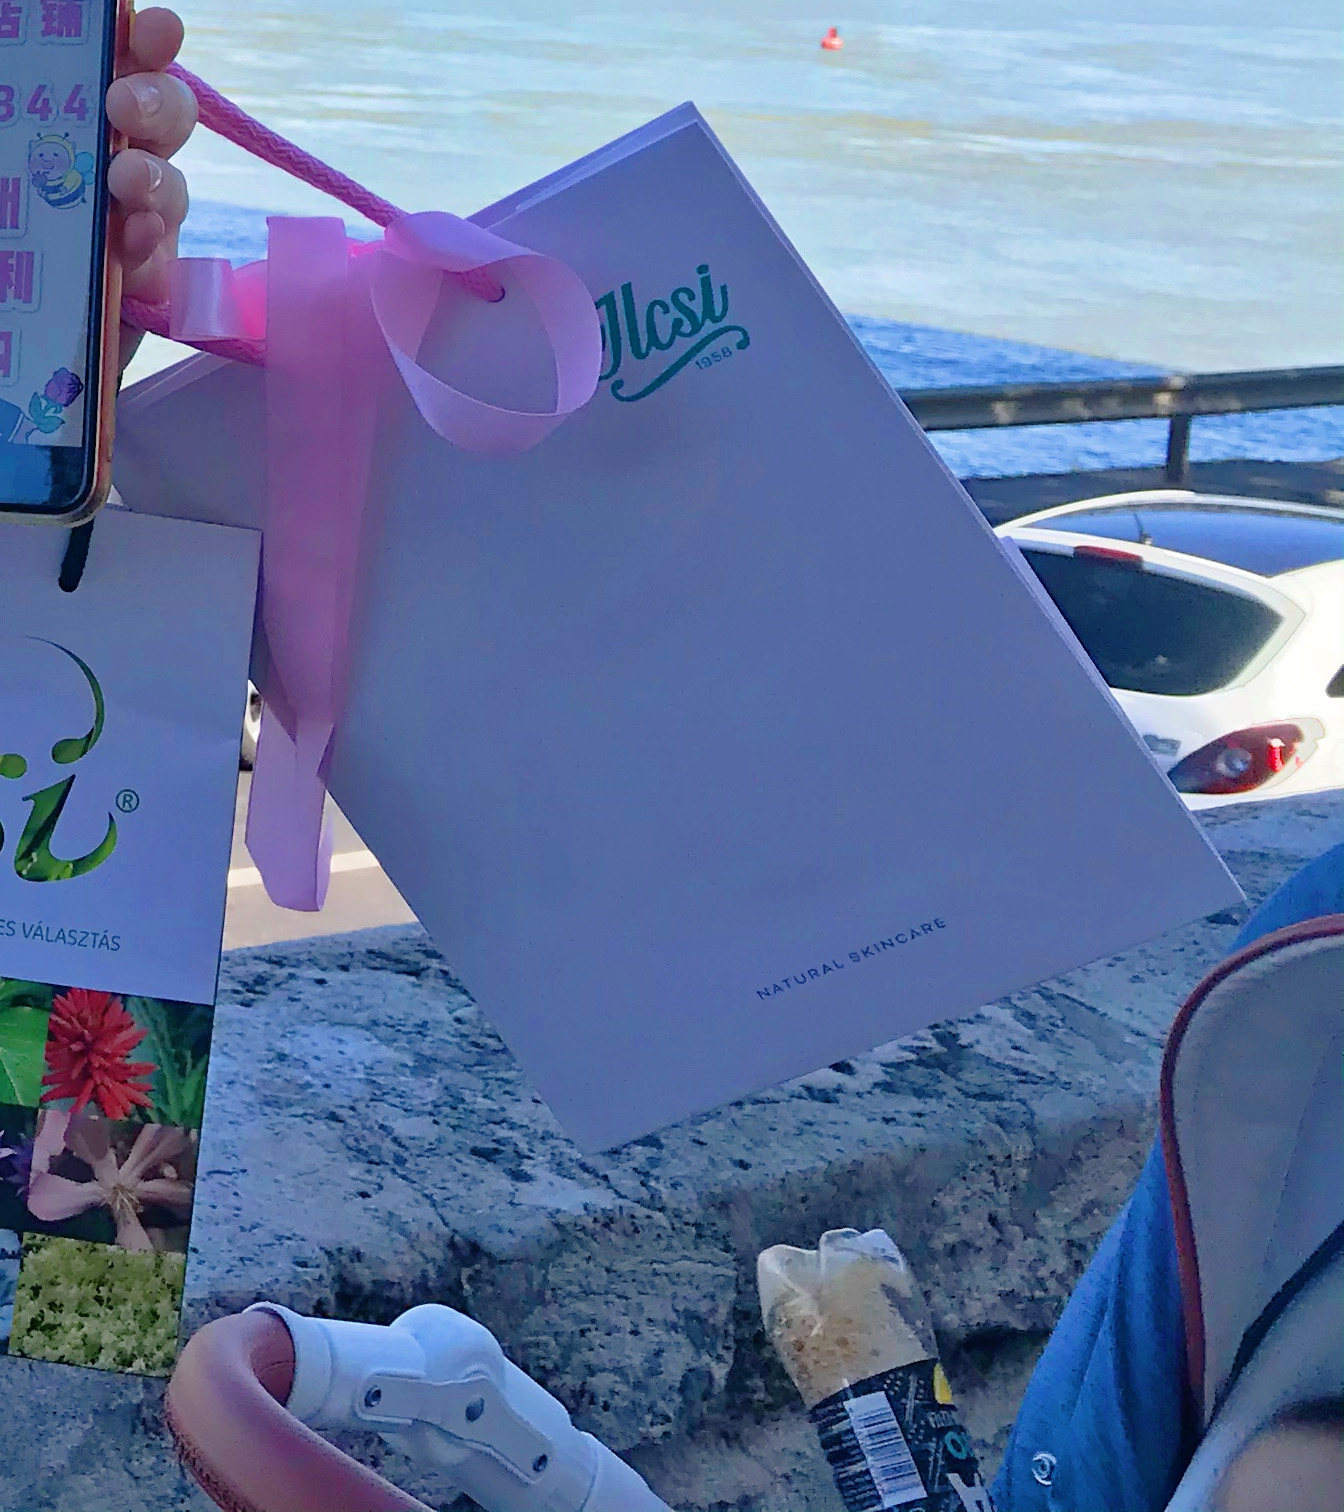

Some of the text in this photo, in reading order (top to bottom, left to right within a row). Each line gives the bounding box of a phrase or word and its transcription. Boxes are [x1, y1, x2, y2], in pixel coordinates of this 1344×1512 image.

[22, 920, 121, 952] VÁLASZTÁS
[756, 917, 947, 1000] NATURAL SKINCARE
